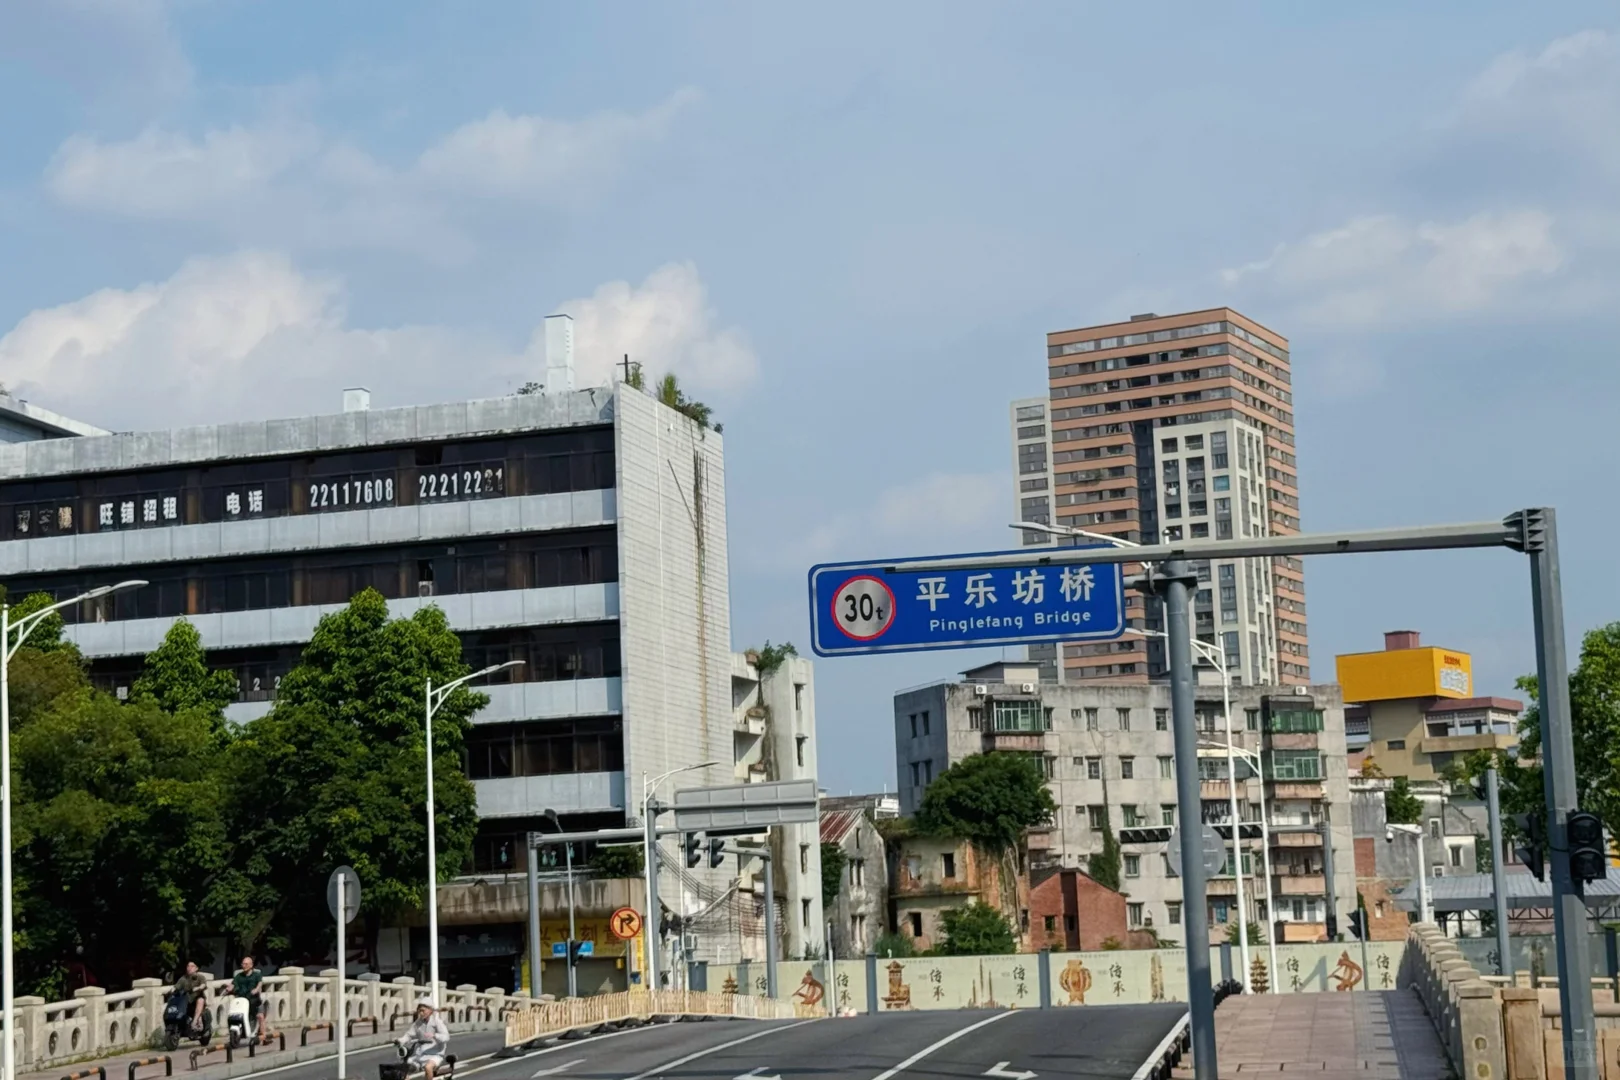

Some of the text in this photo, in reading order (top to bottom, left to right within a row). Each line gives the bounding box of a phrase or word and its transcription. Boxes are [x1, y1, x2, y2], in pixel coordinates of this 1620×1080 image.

[100, 497, 177, 525] 旺铺招租
[226, 489, 263, 515] 电话
[310, 478, 394, 508] 22117608
[916, 565, 1096, 612] 平乐坊桥
[929, 610, 1092, 632] Pinglefang Bridge
